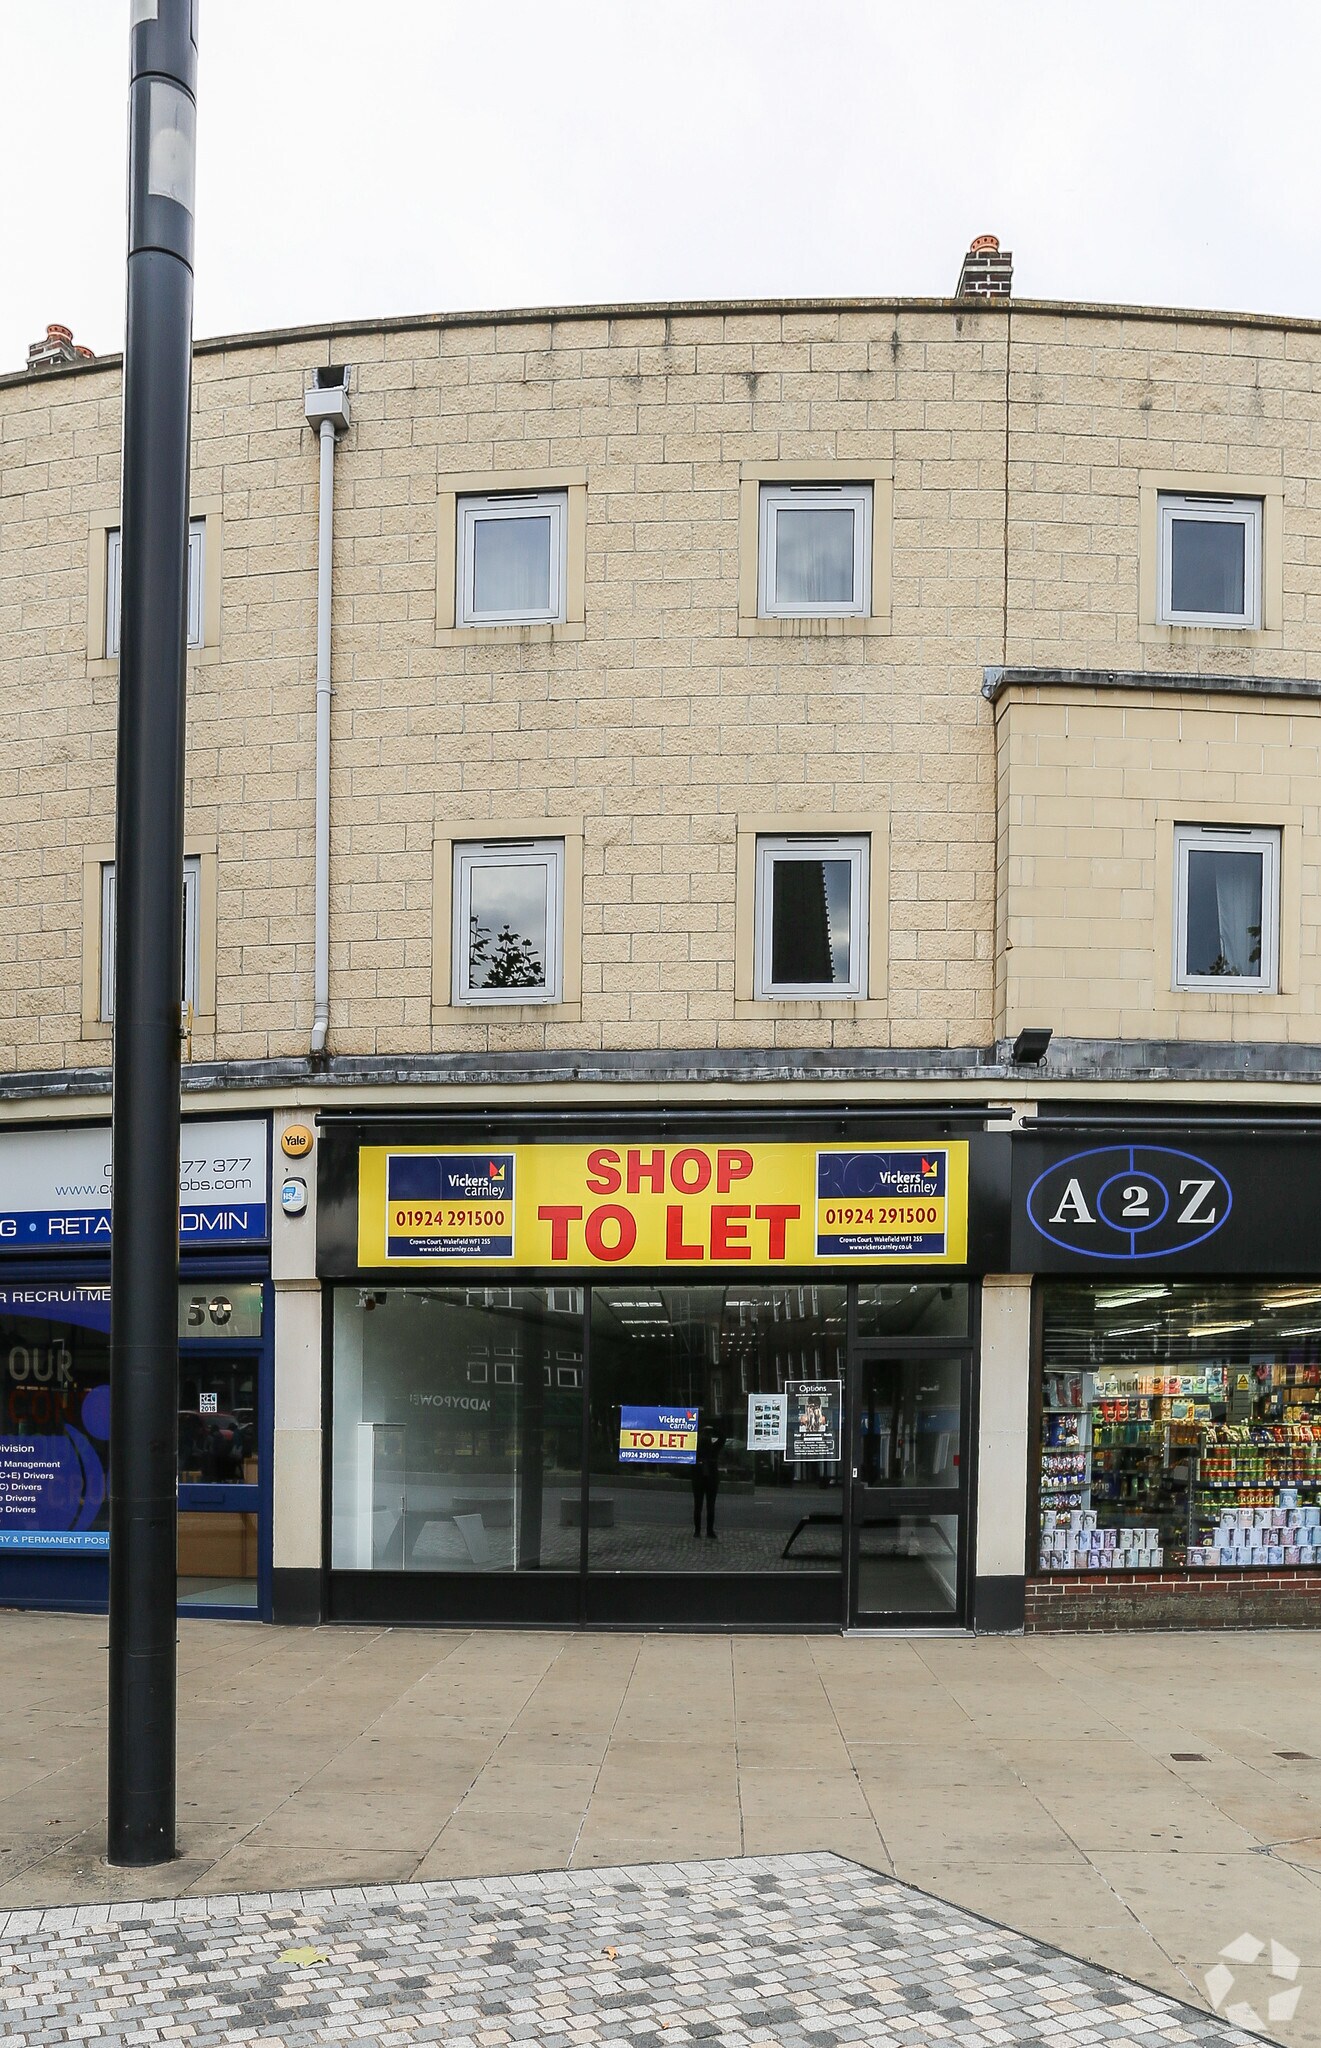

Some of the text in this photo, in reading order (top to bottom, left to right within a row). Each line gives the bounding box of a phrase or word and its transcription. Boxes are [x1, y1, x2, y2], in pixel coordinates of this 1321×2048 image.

[285, 1136, 306, 1146] Yale
[179, 1158, 252, 1174] 77 377
[586, 1149, 754, 1194] SHOP
[448, 1174, 489, 1187] Vickers
[879, 1171, 921, 1184] Vickers
[465, 1183, 505, 1199] carnley
[896, 1180, 938, 1196] carnley
[1049, 1178, 1217, 1224] A 2 Z
[179, 1211, 248, 1231] DMIN
[396, 1210, 505, 1226] 01924 291500
[826, 1207, 937, 1224] 01924 291500
[538, 1204, 800, 1261] TO LET
[426, 1238, 442, 1246] Court,
[187, 1295, 233, 1327] 50
[8, 1346, 74, 1382] OUR
[799, 1384, 827, 1393] Options
[658, 1415, 686, 1424] Vickers
[669, 1422, 696, 1431] carnley
[630, 1432, 688, 1448] TO LET
[0, 1444, 35, 1453] ivision
[4, 1460, 61, 1470] Management
[11, 1483, 42, 1491] Drivers
[5, 1494, 36, 1502] Drivers
[21, 1536, 82, 1544] PERMANENT
